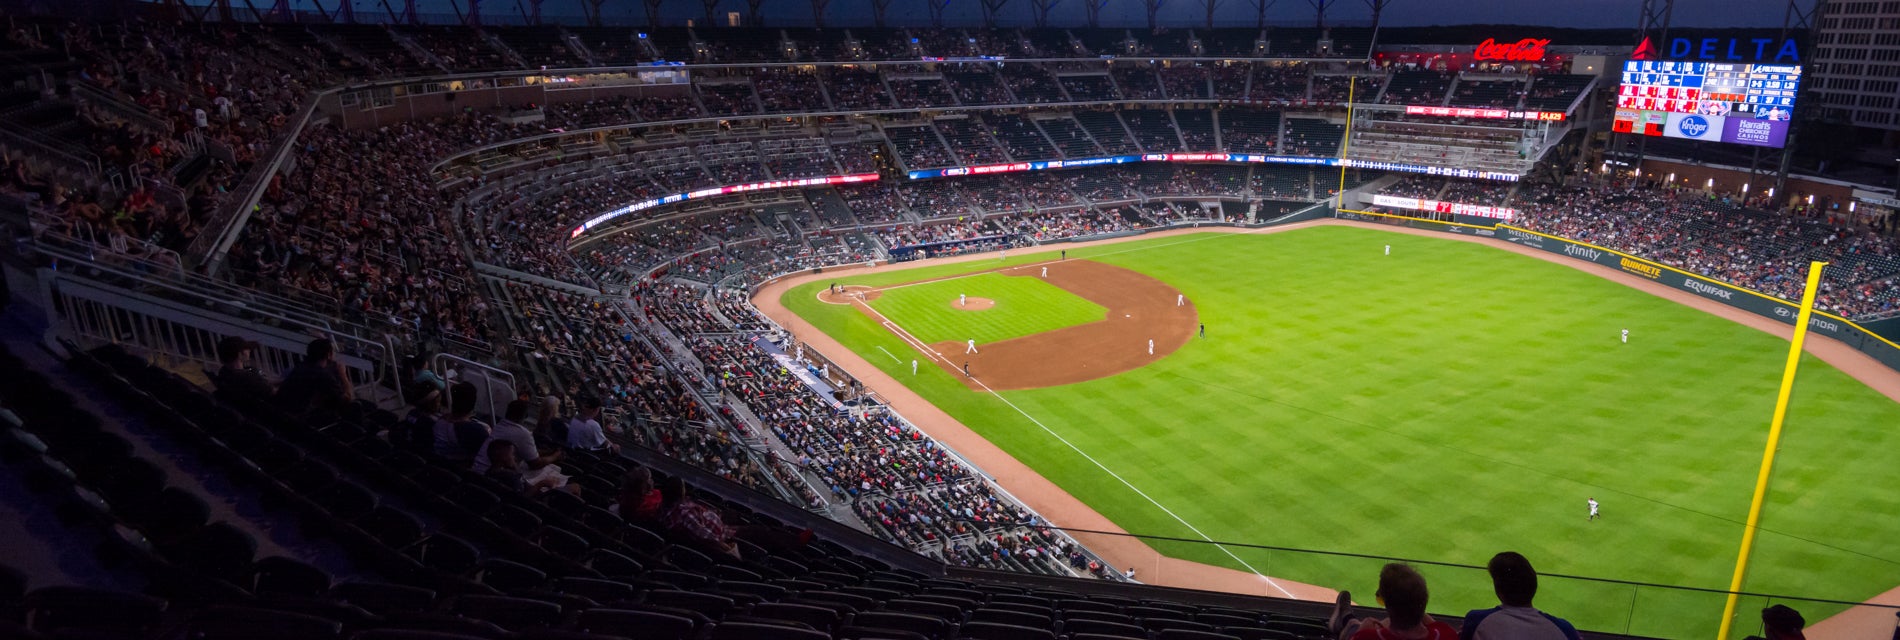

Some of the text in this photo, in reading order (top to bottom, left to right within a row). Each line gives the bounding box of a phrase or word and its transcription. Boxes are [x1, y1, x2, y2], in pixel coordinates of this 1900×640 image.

[1474, 37, 1551, 61] Coca-Cola
[1670, 37, 1799, 61] DELTA
[1682, 118, 1707, 136] Kroger
[1508, 228, 1543, 242] WELLSTAR
[1564, 244, 1601, 261] xfinity
[1620, 257, 1661, 276] QUIKRETE
[1684, 278, 1733, 300] EQUIFAX
